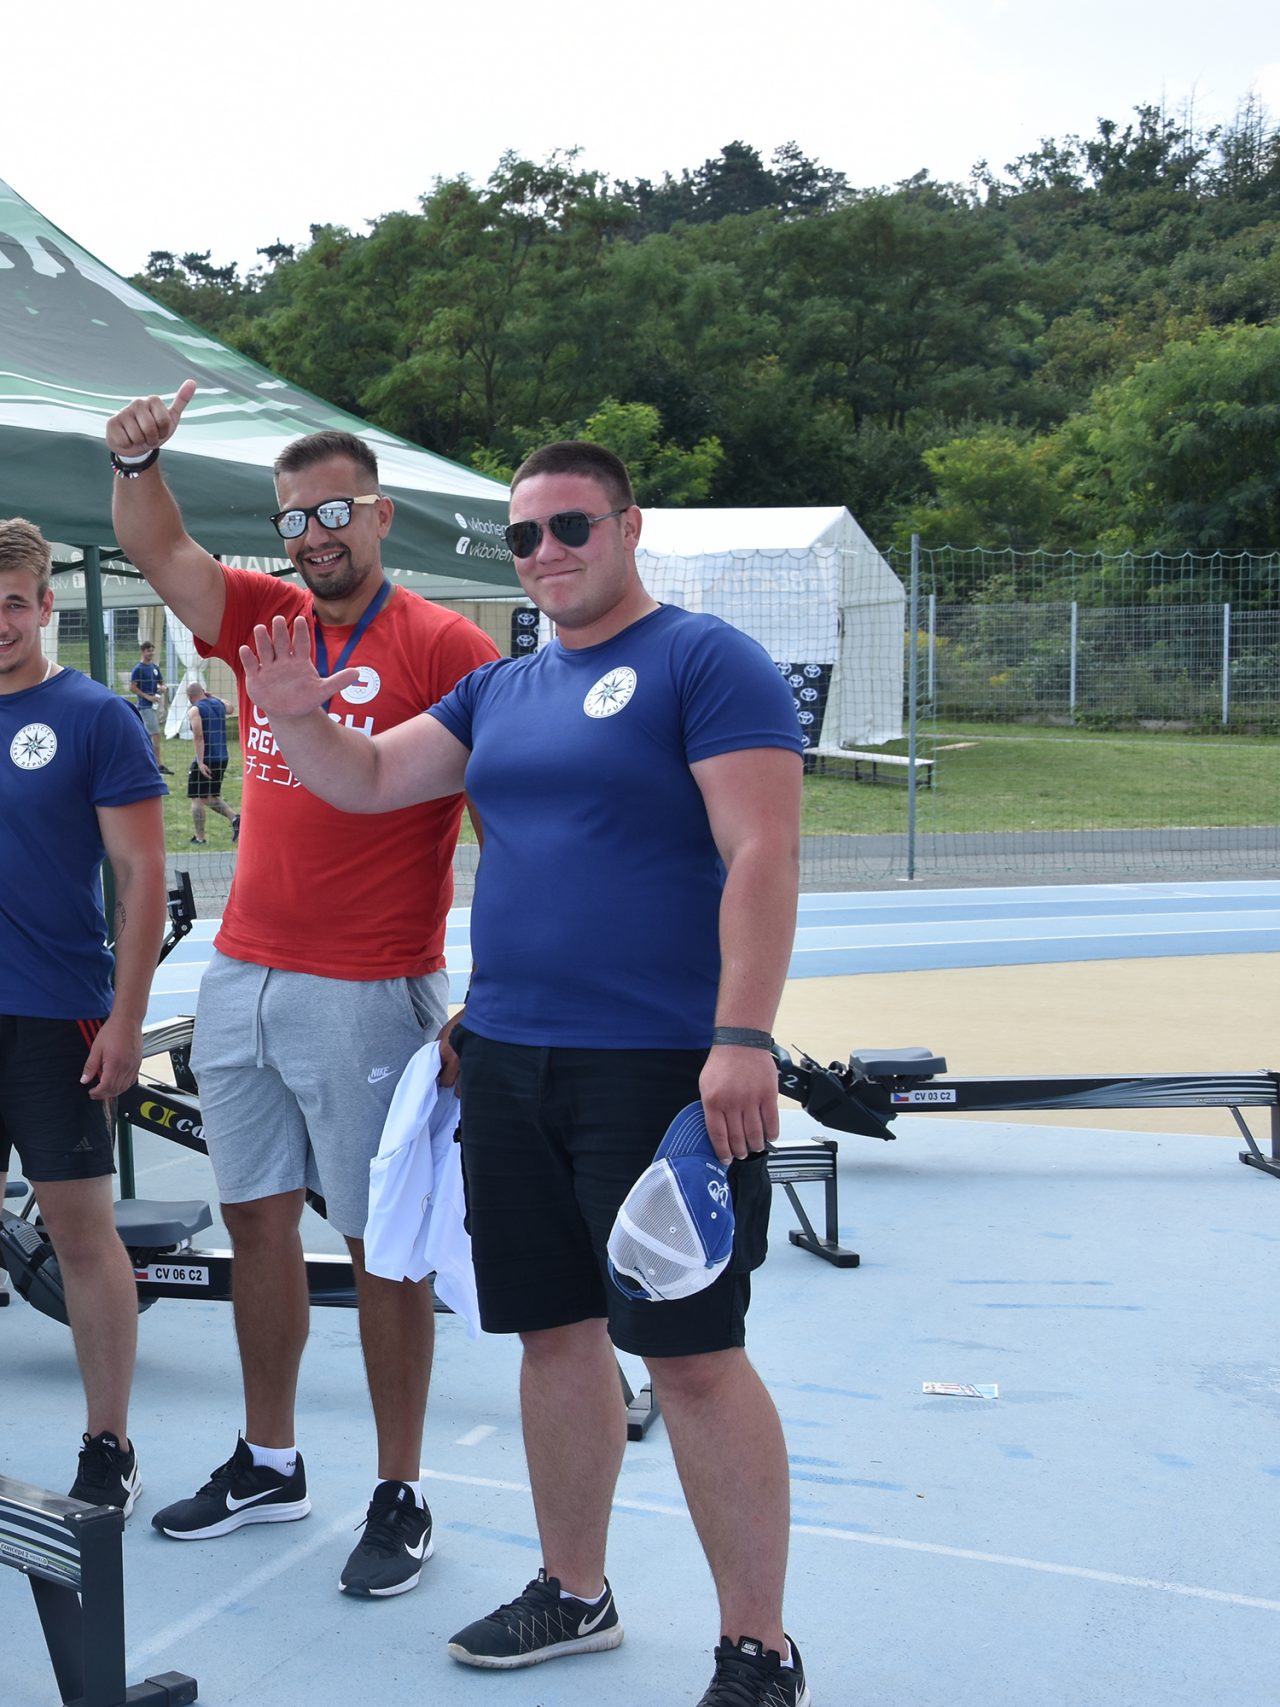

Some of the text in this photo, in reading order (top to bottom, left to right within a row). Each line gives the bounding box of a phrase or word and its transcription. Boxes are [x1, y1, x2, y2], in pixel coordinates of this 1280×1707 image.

[371, 1066, 390, 1078] NIKE
[914, 1091, 951, 1101] CV 03 C2
[155, 1267, 202, 1281] CV 06 C2
